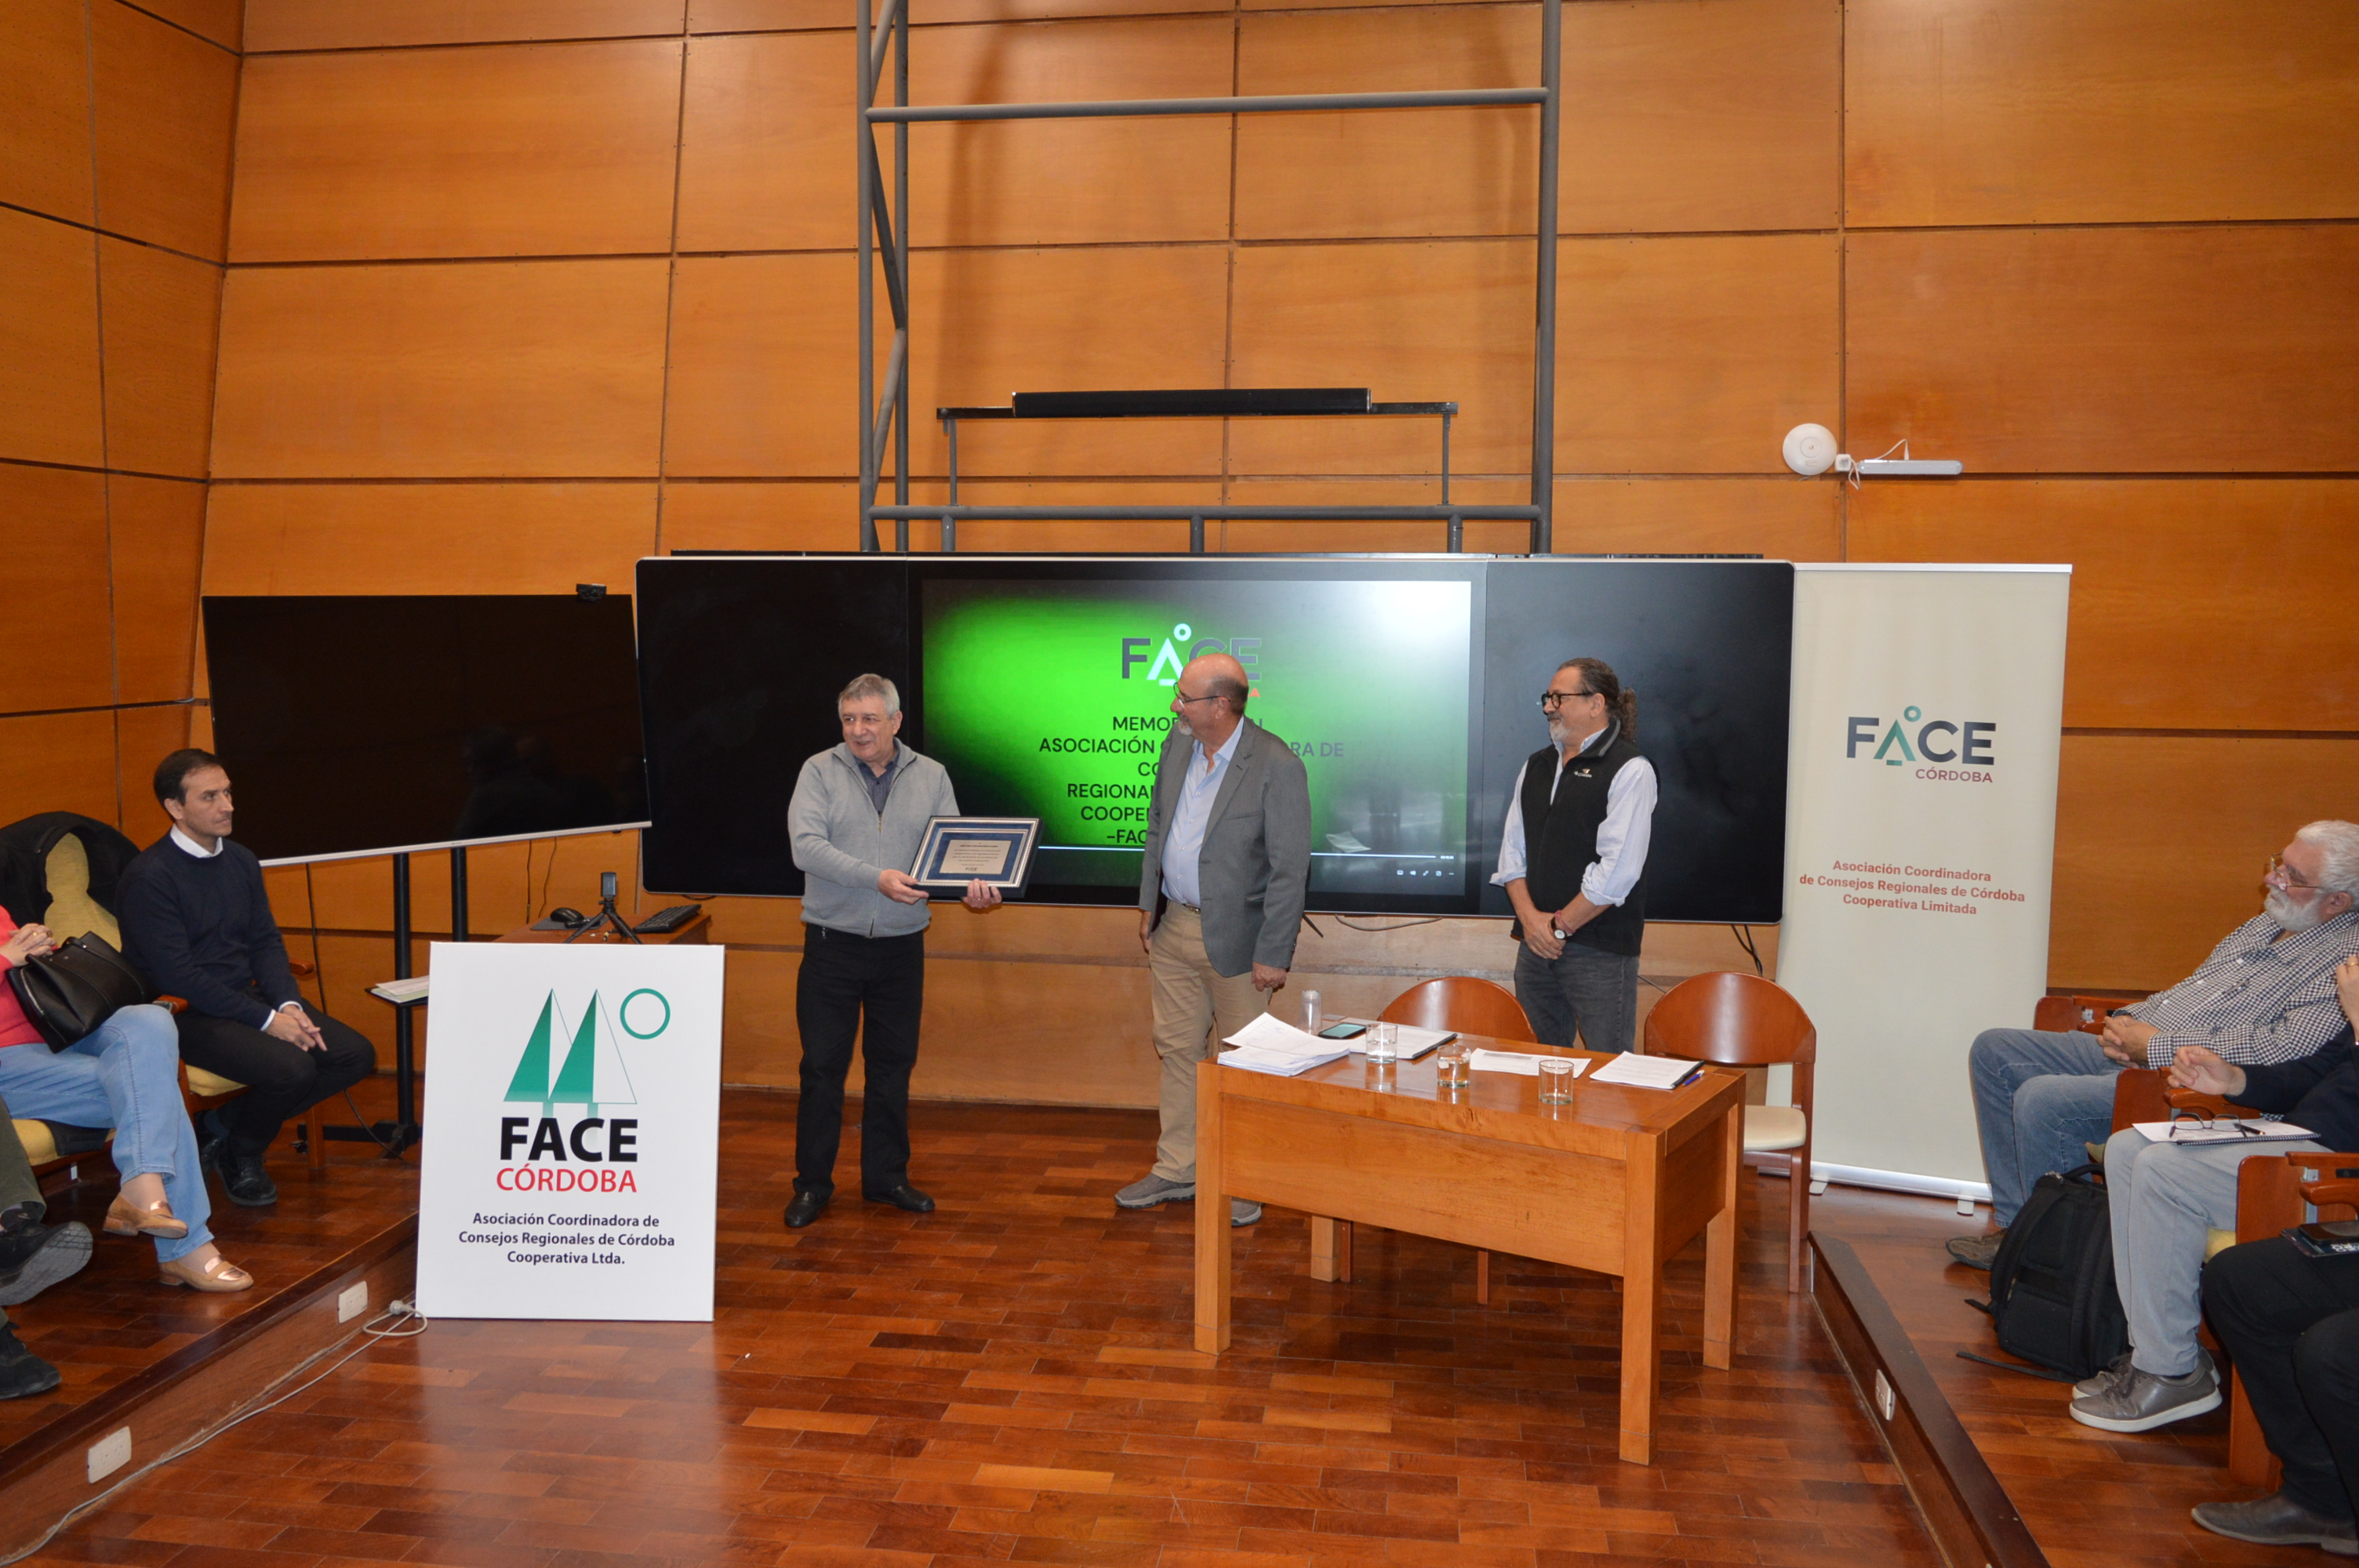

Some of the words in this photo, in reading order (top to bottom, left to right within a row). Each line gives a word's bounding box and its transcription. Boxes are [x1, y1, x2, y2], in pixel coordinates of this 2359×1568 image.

[1038, 735, 1155, 754] ASOCIACIÓN
[1320, 742, 1344, 757] DE
[1846, 716, 1997, 767] FACE
[1915, 766, 1994, 783] CÓRDOBA
[1833, 860, 1901, 876] Asociación
[1904, 866, 1992, 882] Coordinadora
[1799, 874, 1815, 885] de
[1817, 876, 1874, 891] Consejos
[1877, 880, 1947, 895] Regionales
[1951, 885, 1967, 897] de
[1970, 887, 2026, 902] Córdoba
[1843, 894, 1917, 910] Cooperativa
[1921, 900, 1977, 915] Limitada
[500, 1116, 638, 1163] FACE
[496, 1163, 638, 1193] CÓRDOBA
[473, 1212, 544, 1225] Asociación
[547, 1213, 639, 1227] Coordinadora
[642, 1214, 660, 1227] de
[459, 1231, 518, 1247] Consejos
[522, 1232, 594, 1247] Regionales
[598, 1232, 615, 1246] de
[618, 1232, 675, 1247] Córdoba
[507, 1250, 588, 1265] Cooperativa
[592, 1252, 626, 1265] Ltda.
